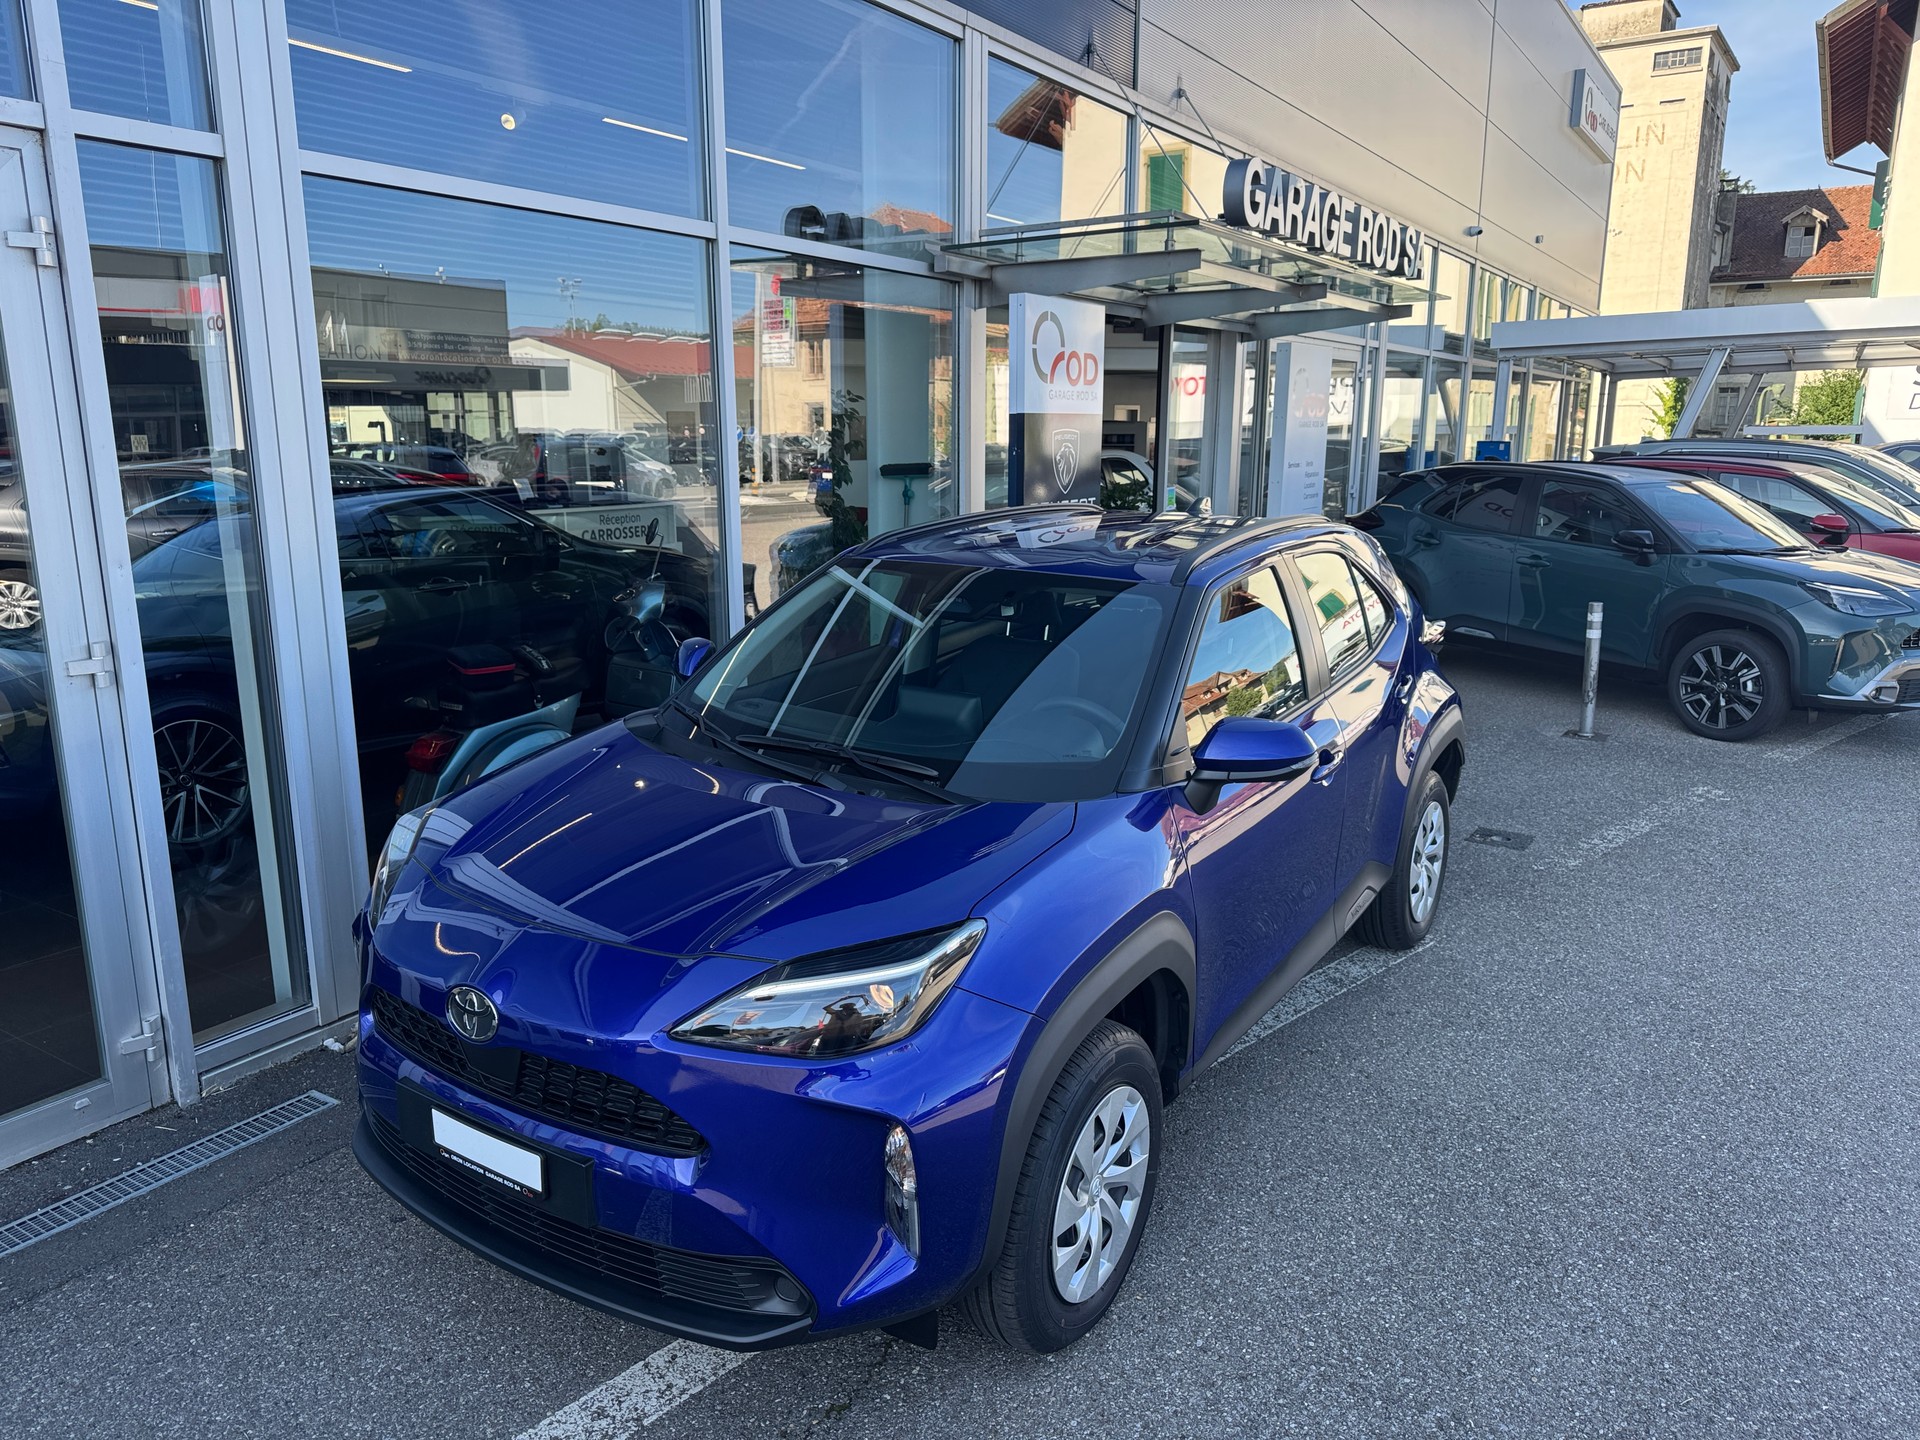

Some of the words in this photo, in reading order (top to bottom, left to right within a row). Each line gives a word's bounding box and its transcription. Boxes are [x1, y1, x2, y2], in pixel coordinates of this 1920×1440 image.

[1240, 157, 1355, 257] GARAGE
[1357, 206, 1400, 272] ROD
[1404, 225, 1425, 280] SA
[1049, 389, 1075, 400] GARAGE
[1076, 390, 1089, 400] ROD
[600, 514, 641, 526] Réception
[463, 1160, 485, 1174] LOCATION
[485, 1171, 504, 1184] GARAGE
